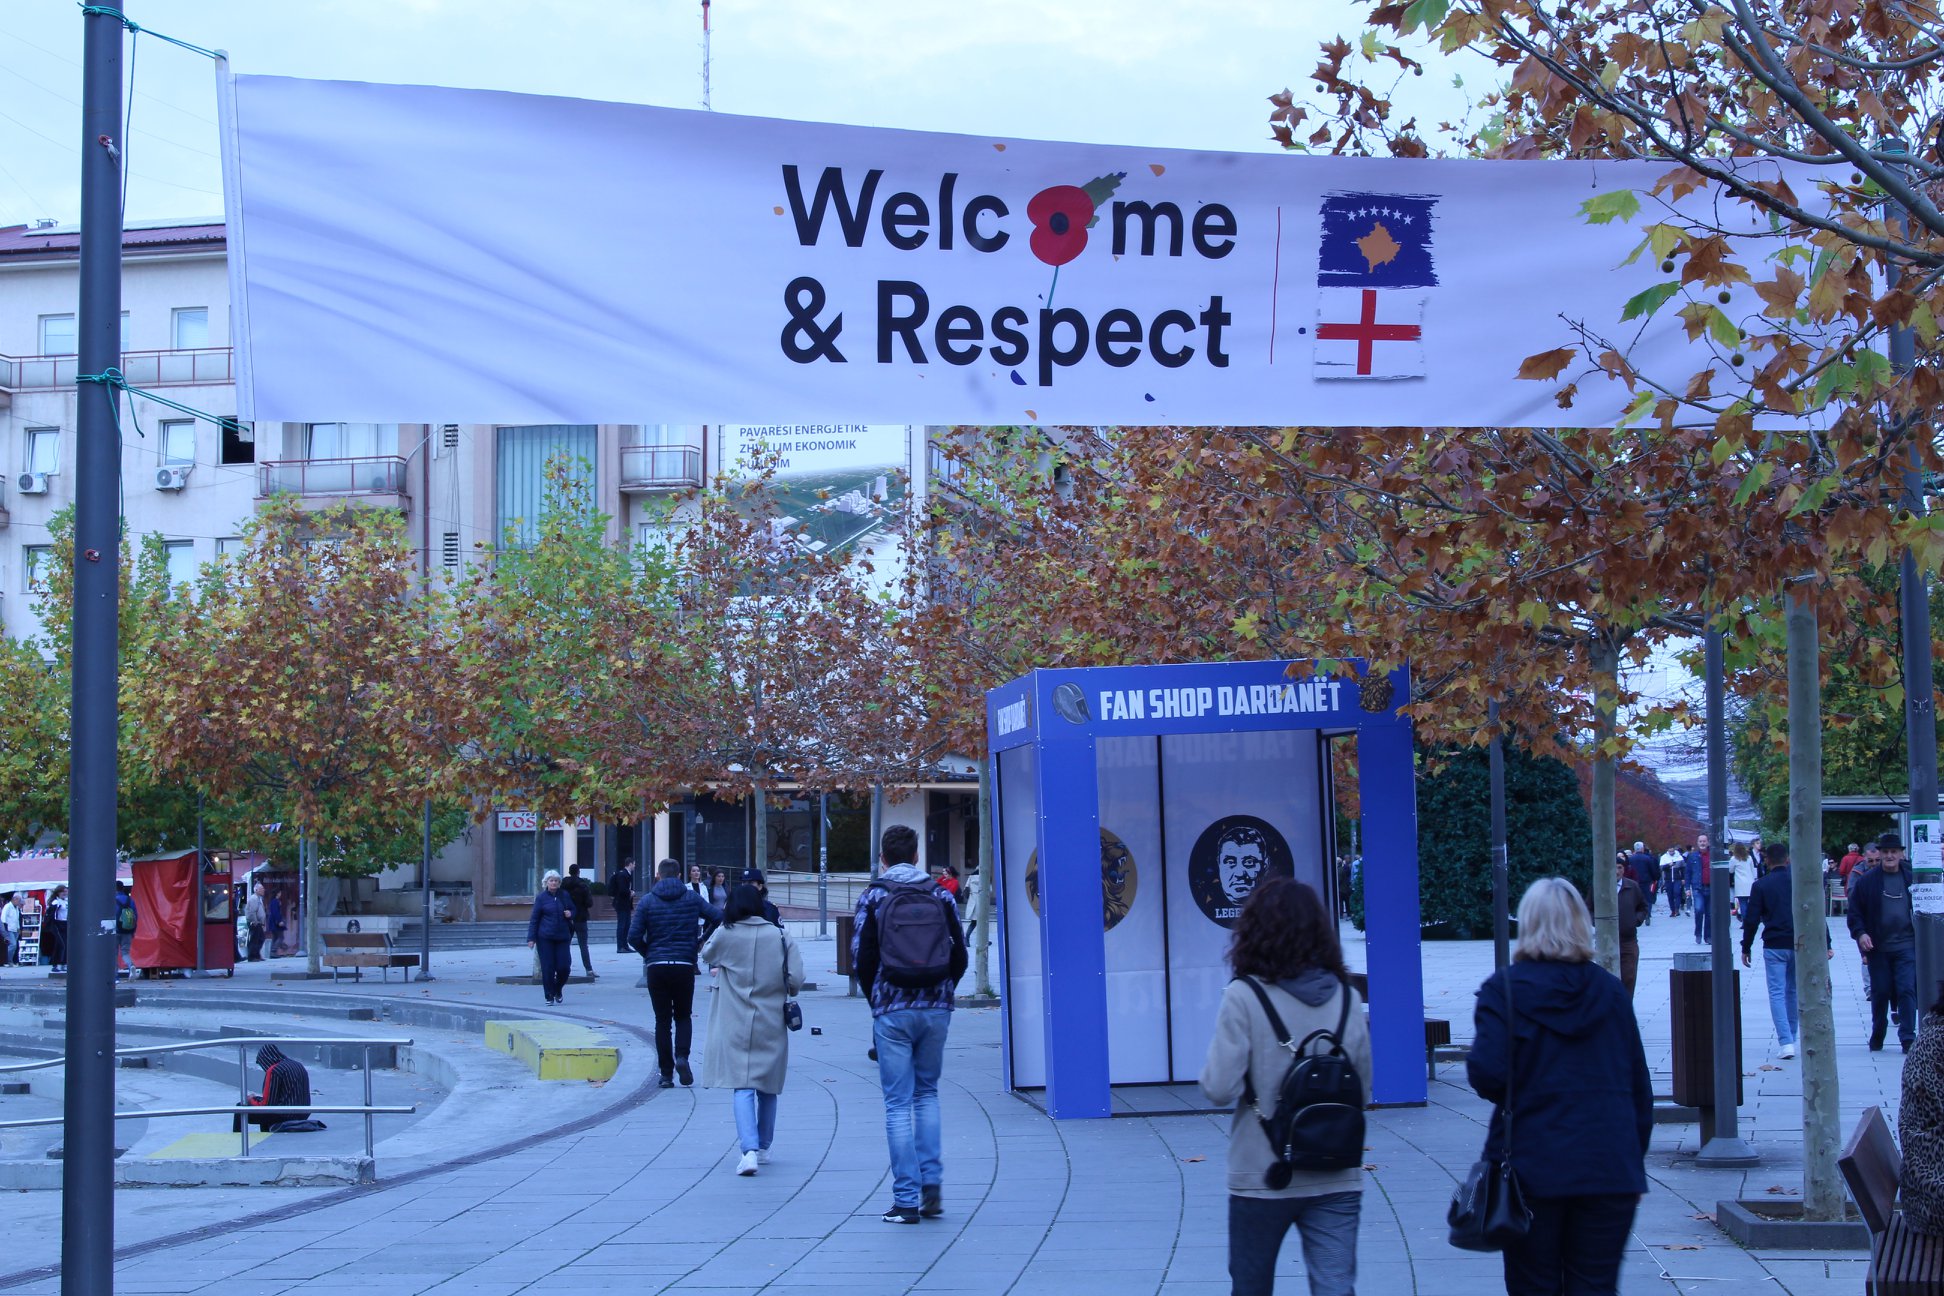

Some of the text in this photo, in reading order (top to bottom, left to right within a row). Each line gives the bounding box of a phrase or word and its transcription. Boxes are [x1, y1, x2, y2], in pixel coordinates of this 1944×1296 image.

[782, 164, 1237, 260] Welcme
[780, 276, 1231, 387] & Respect
[740, 440, 857, 454] ZHVLLIM EKONOMIK
[1100, 676, 1341, 721] FAN SHOP DARDANËT
